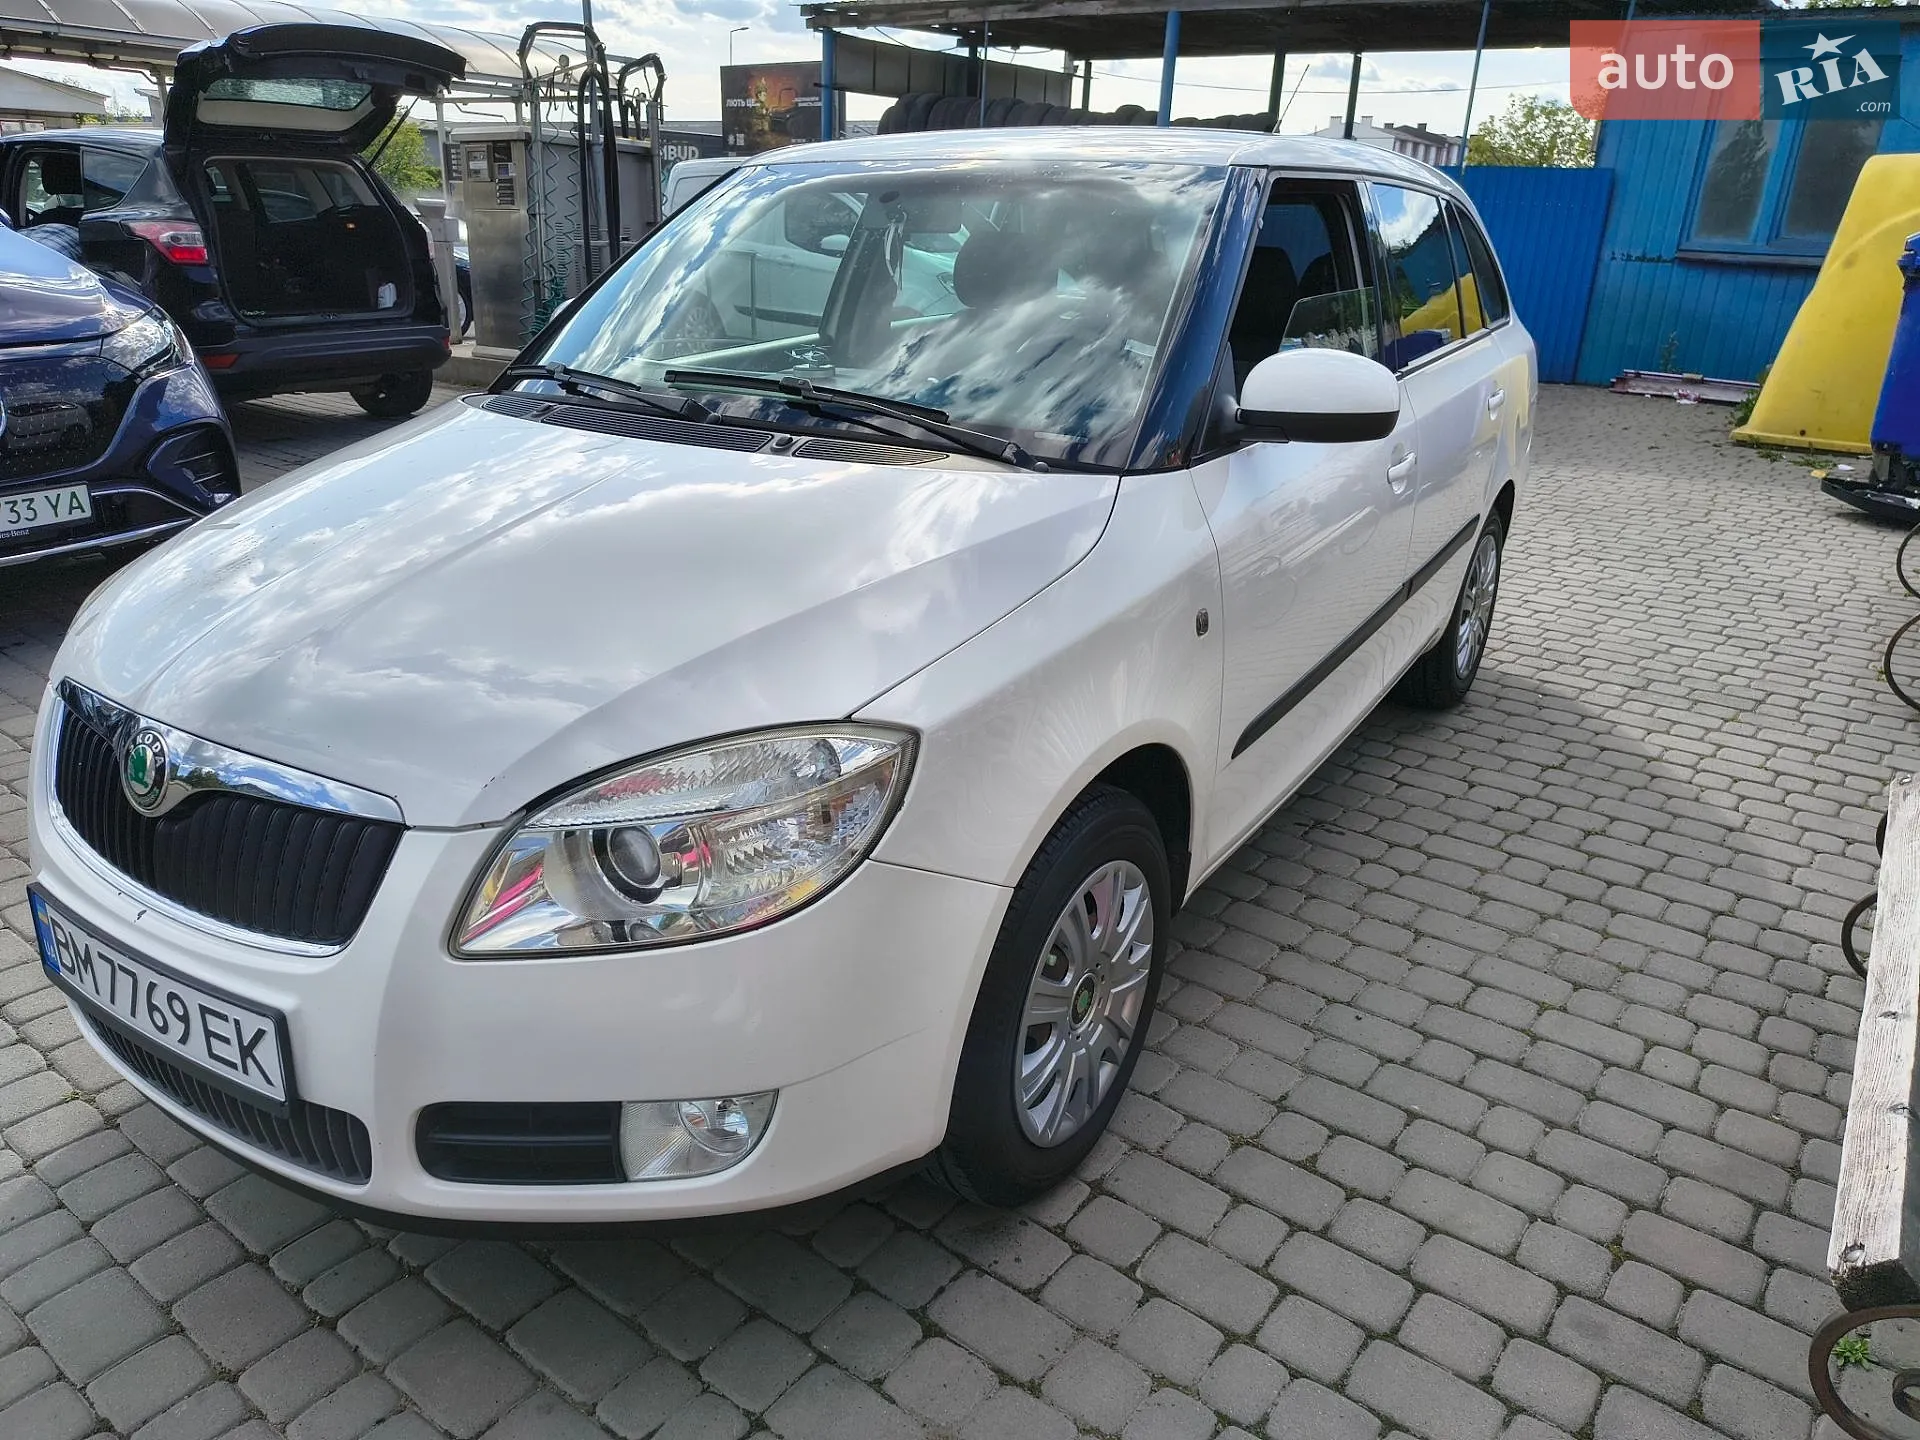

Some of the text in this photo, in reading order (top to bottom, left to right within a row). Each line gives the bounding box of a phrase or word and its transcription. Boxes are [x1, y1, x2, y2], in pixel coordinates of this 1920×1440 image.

[0, 491, 85, 524] 33 YA
[0, 529, 30, 538] es-Benz
